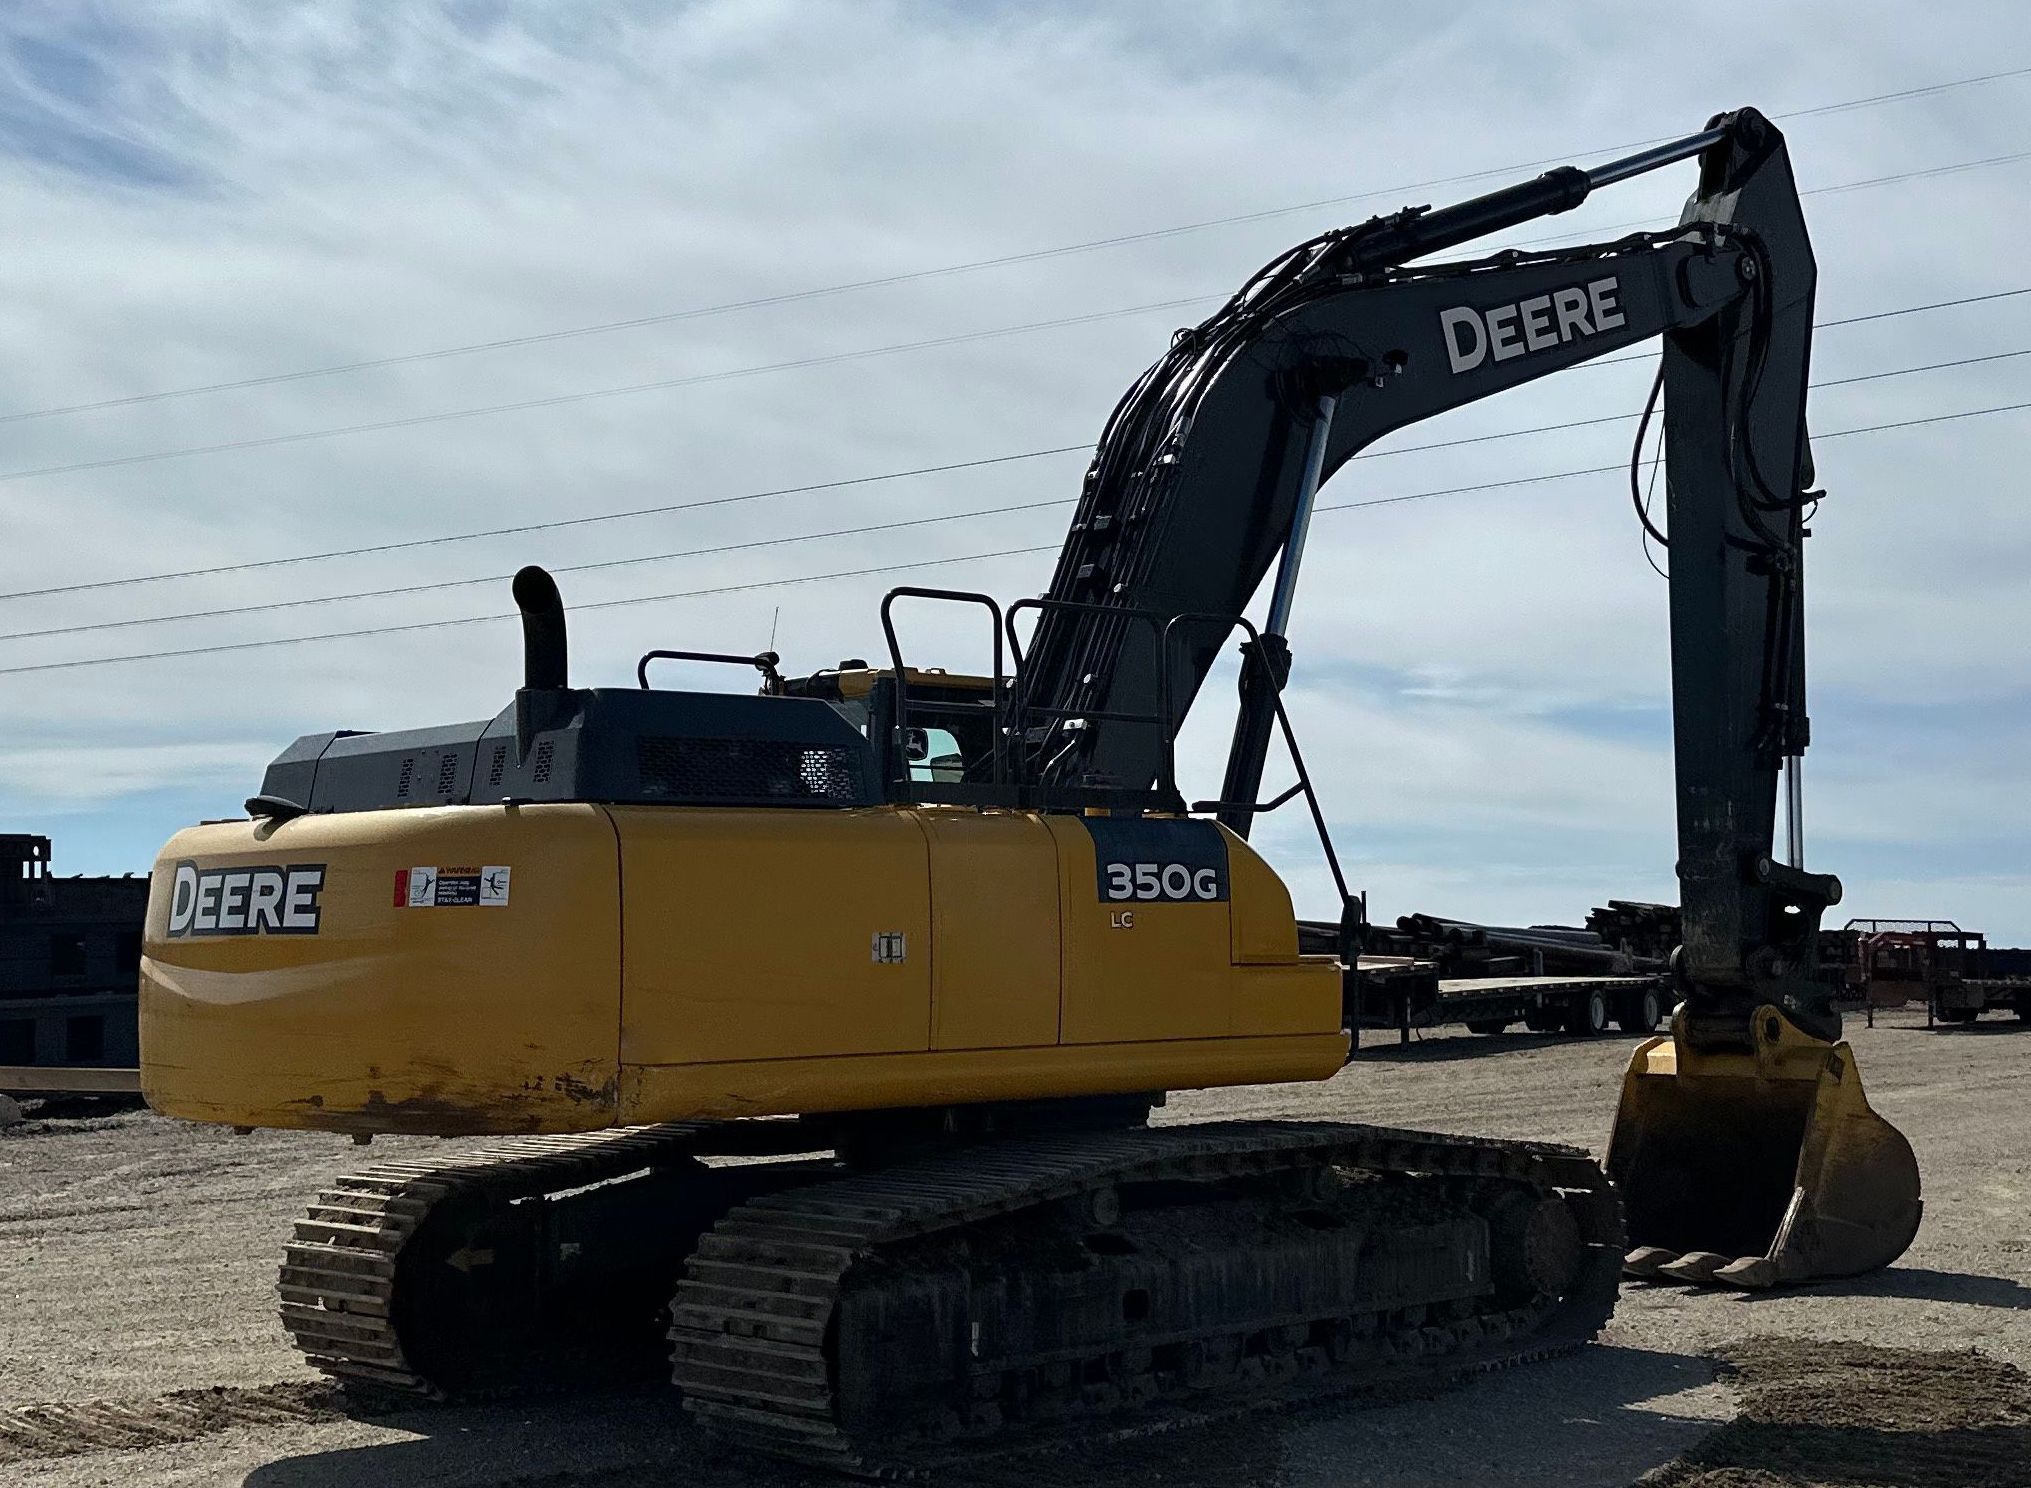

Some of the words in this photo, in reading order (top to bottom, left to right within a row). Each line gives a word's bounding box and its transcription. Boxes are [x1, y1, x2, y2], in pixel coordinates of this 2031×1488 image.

[1440, 276, 1625, 374] DEERE
[169, 866, 322, 931] DEERE
[1107, 863, 1217, 899] 350G
[1110, 911, 1133, 928] LC
